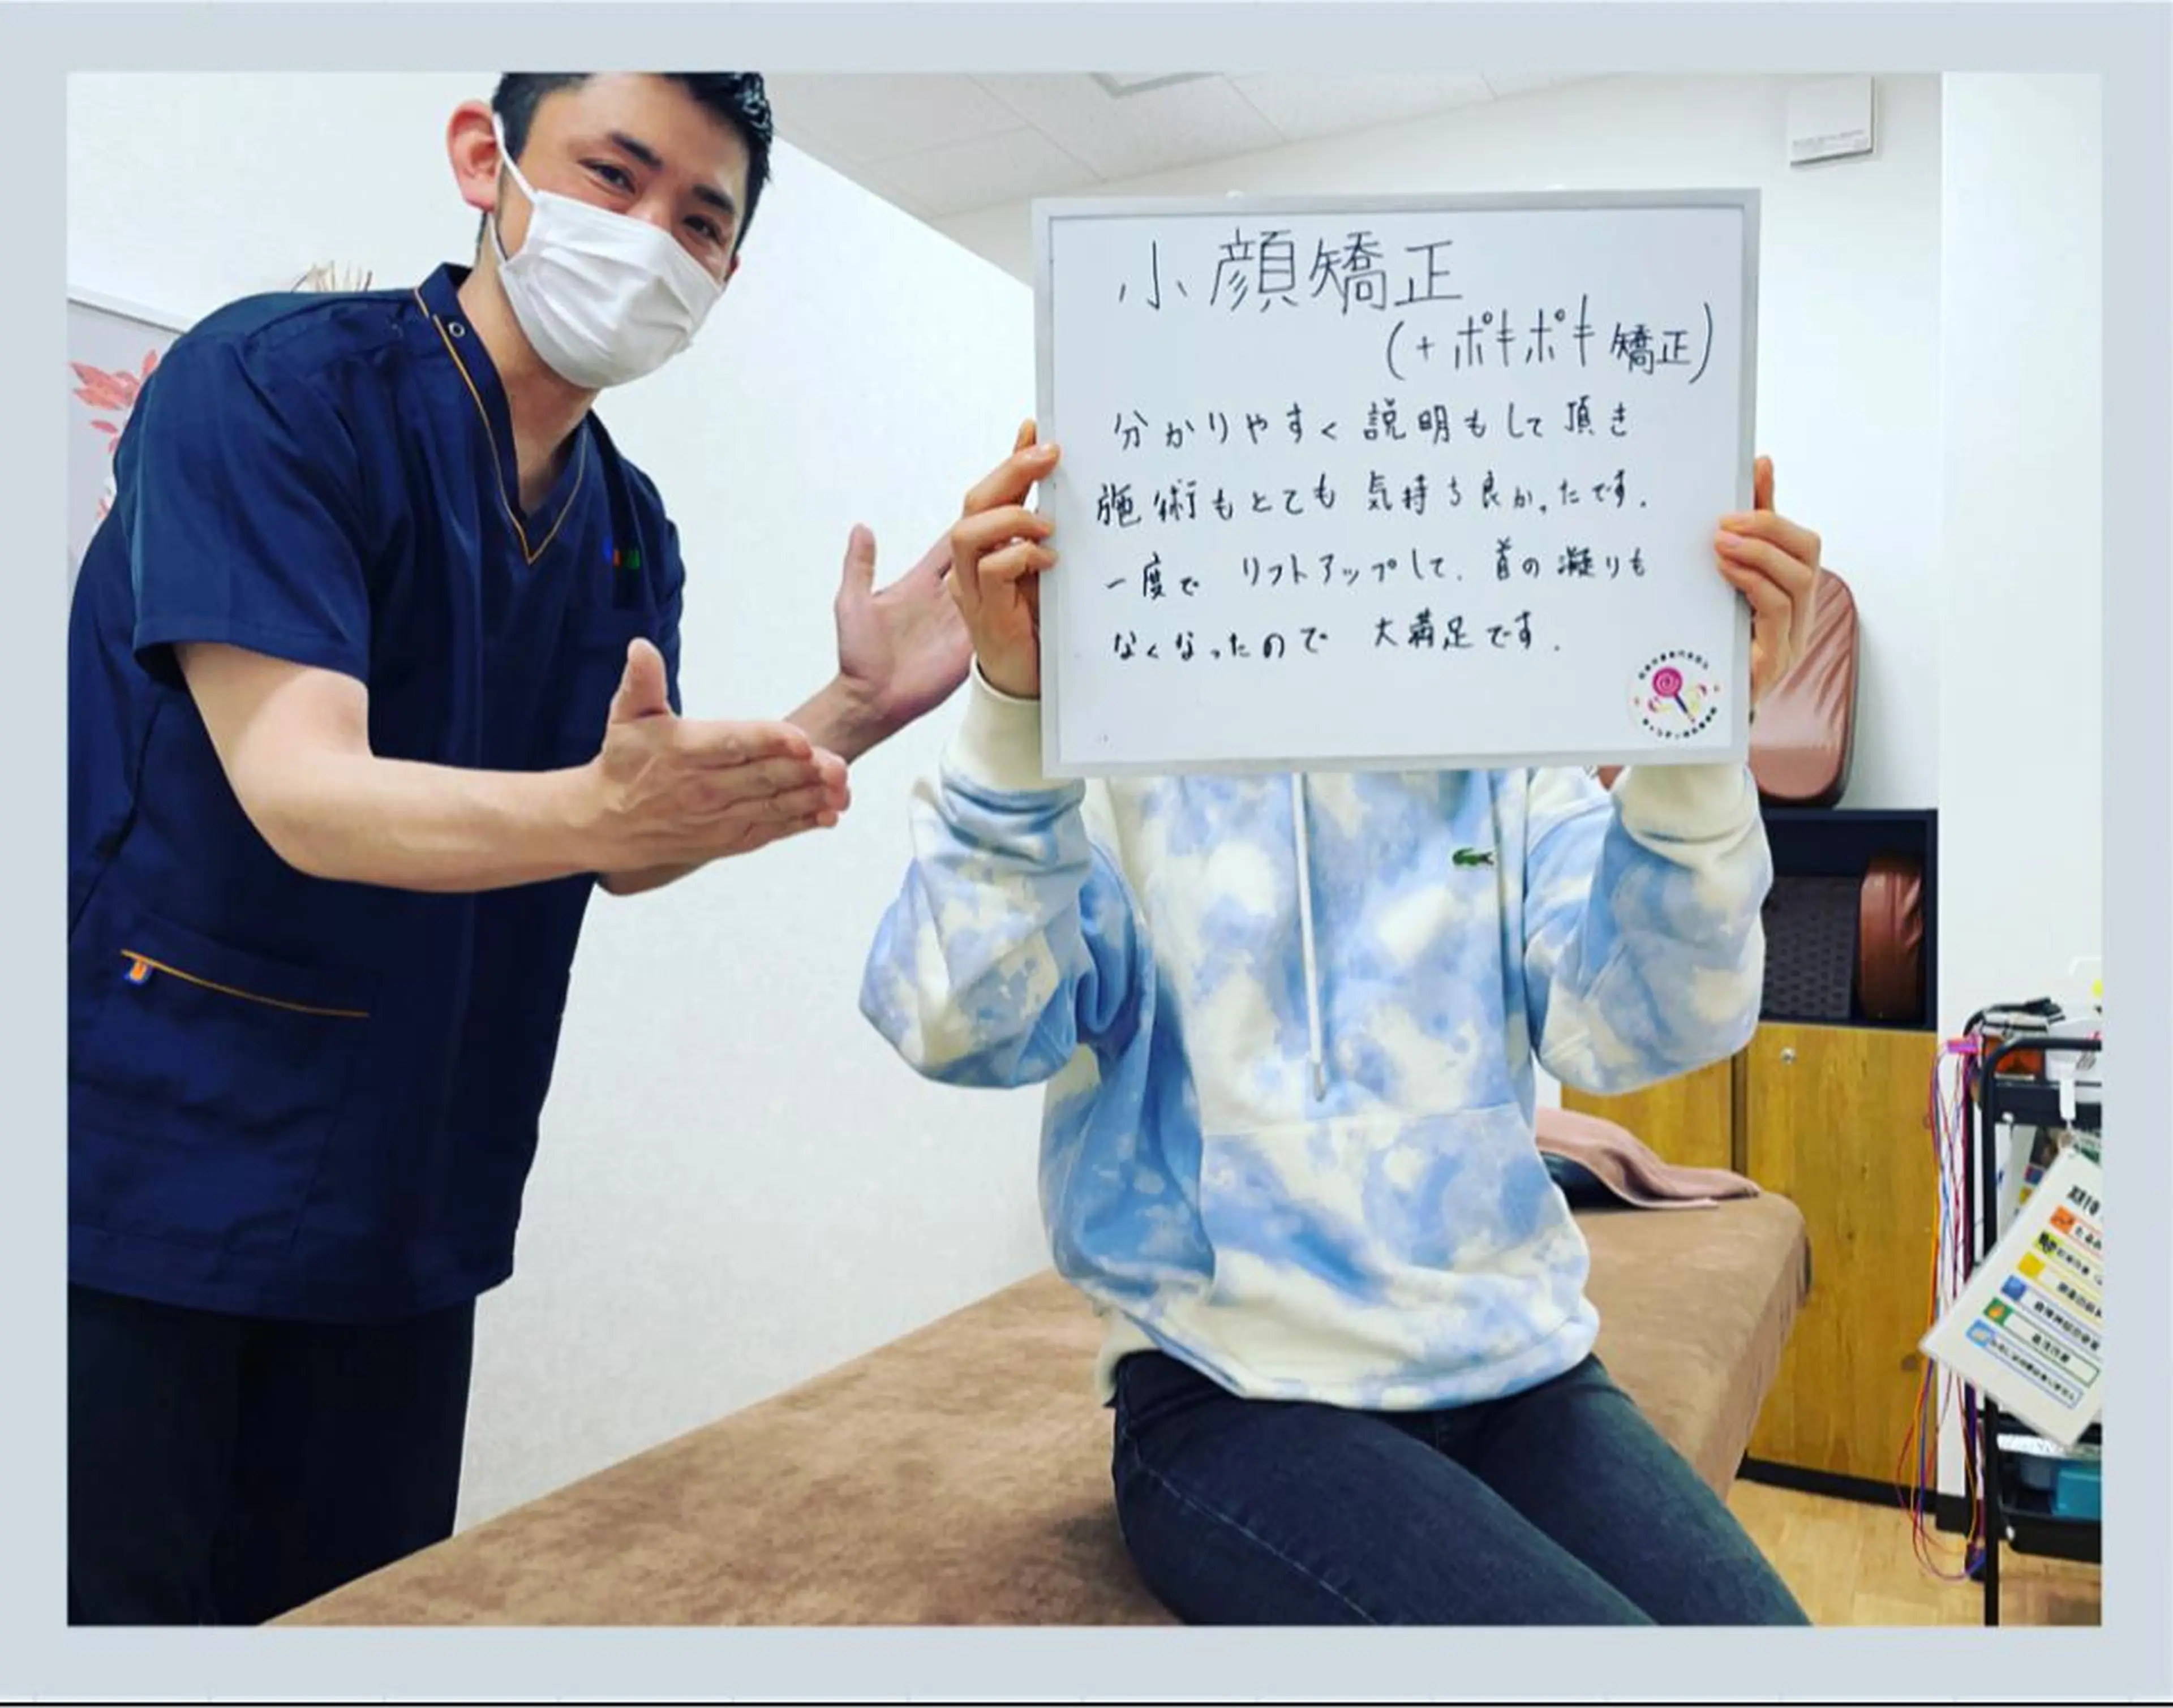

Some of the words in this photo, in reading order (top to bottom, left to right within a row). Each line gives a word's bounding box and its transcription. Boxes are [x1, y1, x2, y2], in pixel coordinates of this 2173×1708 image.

[1117, 227, 1463, 316] 小顔矯正
[1113, 394, 1629, 451] 分かりやすく説明もして頂き
